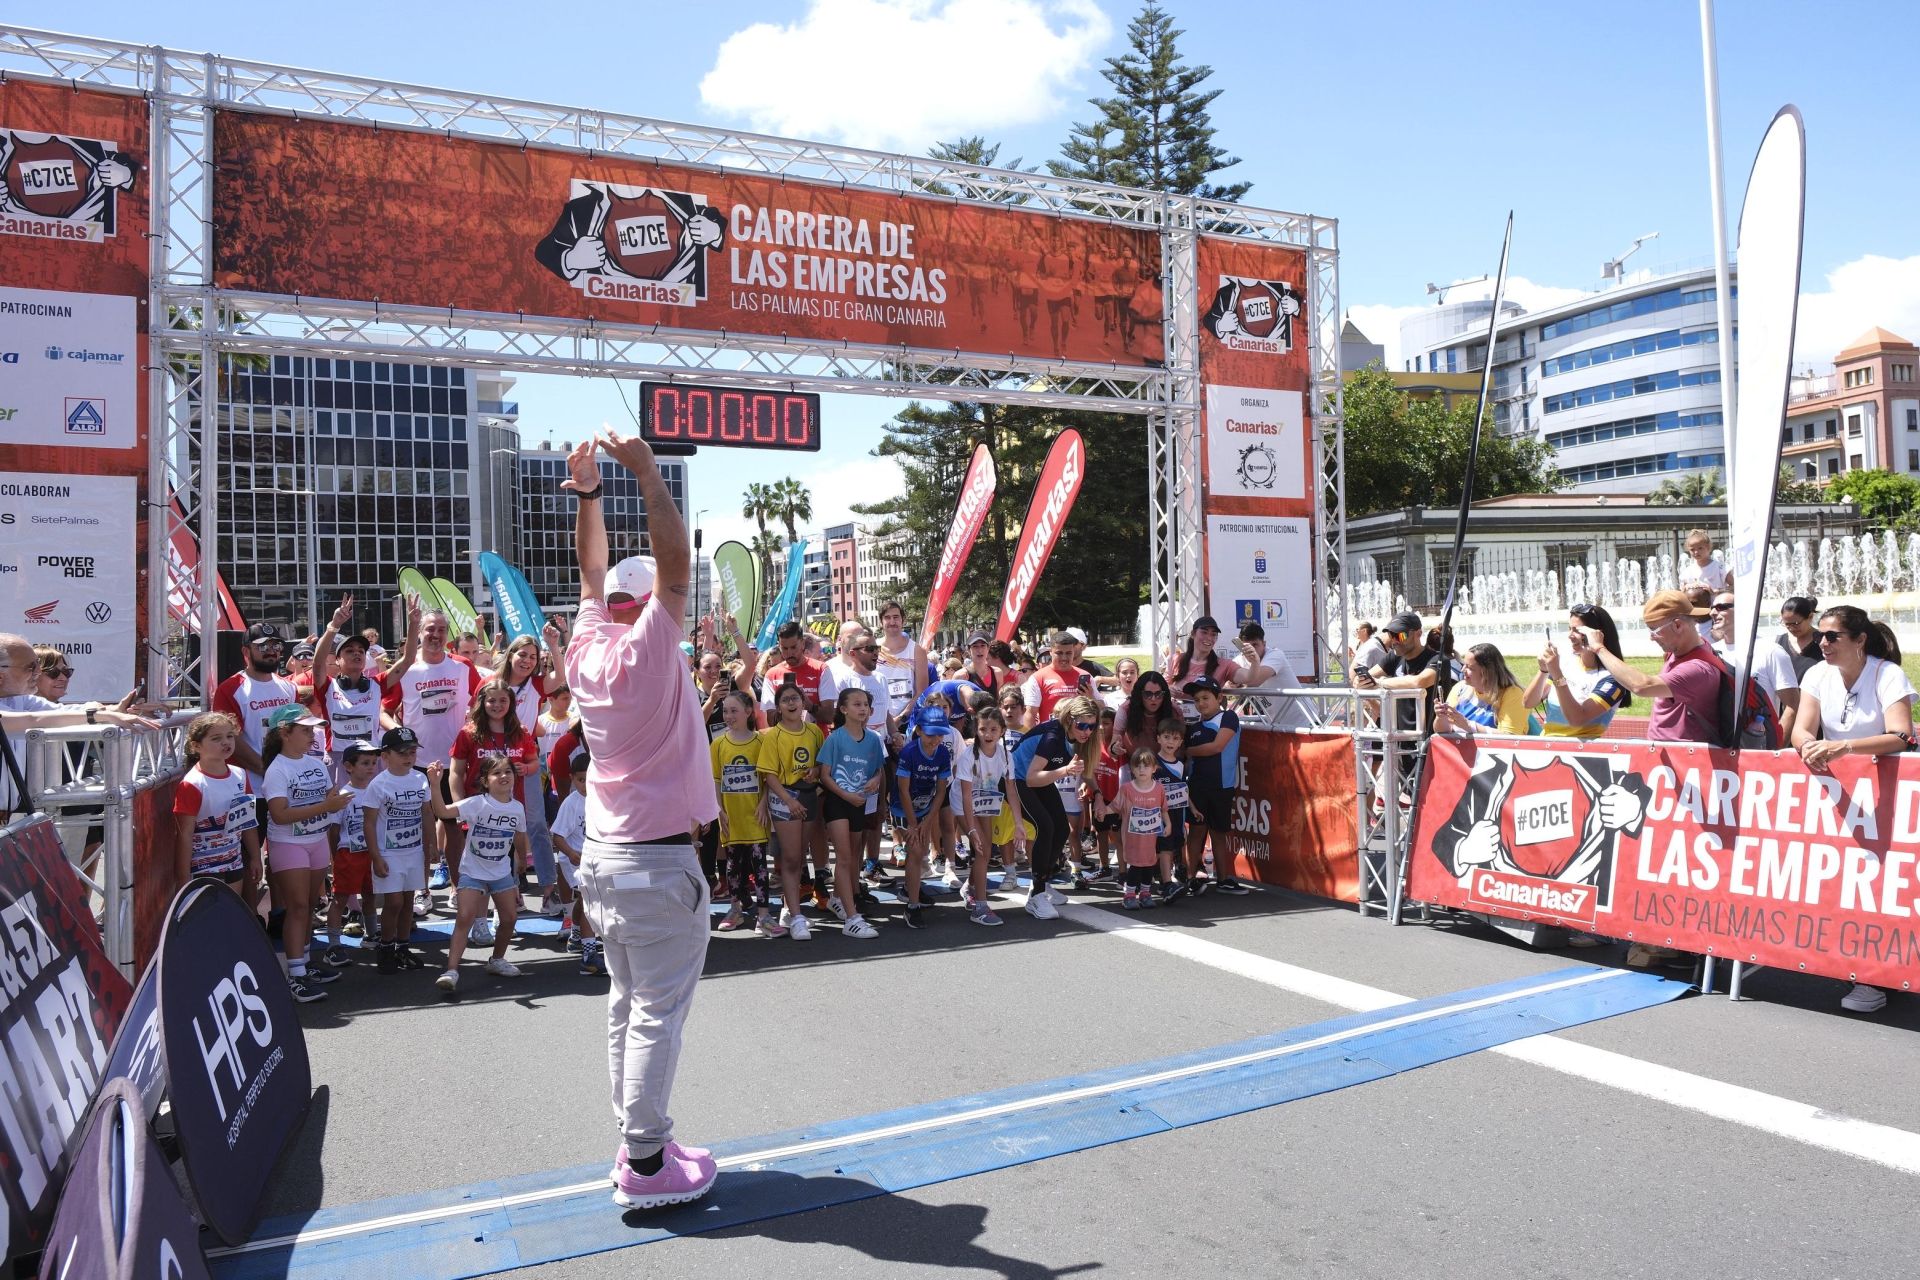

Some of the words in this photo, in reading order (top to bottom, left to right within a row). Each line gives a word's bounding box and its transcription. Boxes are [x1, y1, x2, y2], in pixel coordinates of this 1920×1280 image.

[23, 165, 76, 189] #C7CE
[618, 222, 669, 249] #C7CE
[730, 203, 873, 256] CARRERA
[879, 221, 916, 261] DE
[730, 247, 788, 290] LAS
[793, 253, 948, 304] EMPRESAS
[586, 275, 691, 305] Canarias7
[0, 301, 73, 318] PATROCINAN
[730, 291, 759, 311] LAS
[761, 293, 821, 319] PALMAS
[823, 299, 842, 320] DE
[844, 300, 884, 323] GRAN
[886, 304, 947, 329] CANARIA
[1244, 300, 1272, 318] #C7CE
[1229, 335, 1285, 353] Canarias7
[67, 349, 125, 363] cajamar
[1240, 398, 1270, 409] ORGANIZA
[70, 423, 100, 432] ALDI
[1226, 418, 1284, 435] Canarias7
[0, 484, 71, 498] COLABORAN
[31, 515, 100, 526] SietePalmas
[1219, 523, 1254, 534] PATROCINIO
[1255, 524, 1299, 534] INSTITUCIONAL
[1005, 438, 1079, 623] Canarias7
[38, 556, 95, 567] POWER
[64, 567, 95, 578] ADE
[32, 643, 92, 655] IDARIO
[296, 768, 324, 781] HPS
[395, 789, 426, 801] HPS
[974, 799, 994, 808] 9177
[1645, 764, 1879, 842] CARRERA
[487, 814, 518, 828] HPS
[1516, 800, 1570, 833] #C7CE
[478, 840, 506, 850] 9035
[1233, 836, 1271, 861] CANARIA
[1636, 826, 1724, 893] LAS
[1729, 836, 1920, 918] EMPRE
[1477, 872, 1589, 914] Canarias7
[1633, 889, 1676, 928] LAS
[1681, 898, 1786, 946] PALMAS
[1795, 910, 1832, 953] DE
[1839, 919, 1920, 967] GRAN
[192, 960, 273, 1123] HPS
[226, 1107, 250, 1151] HOSPITAL
[245, 1069, 266, 1111] PERPETUO
[263, 1045, 285, 1078] SOCORRO
[0, 955, 106, 1266] TART
